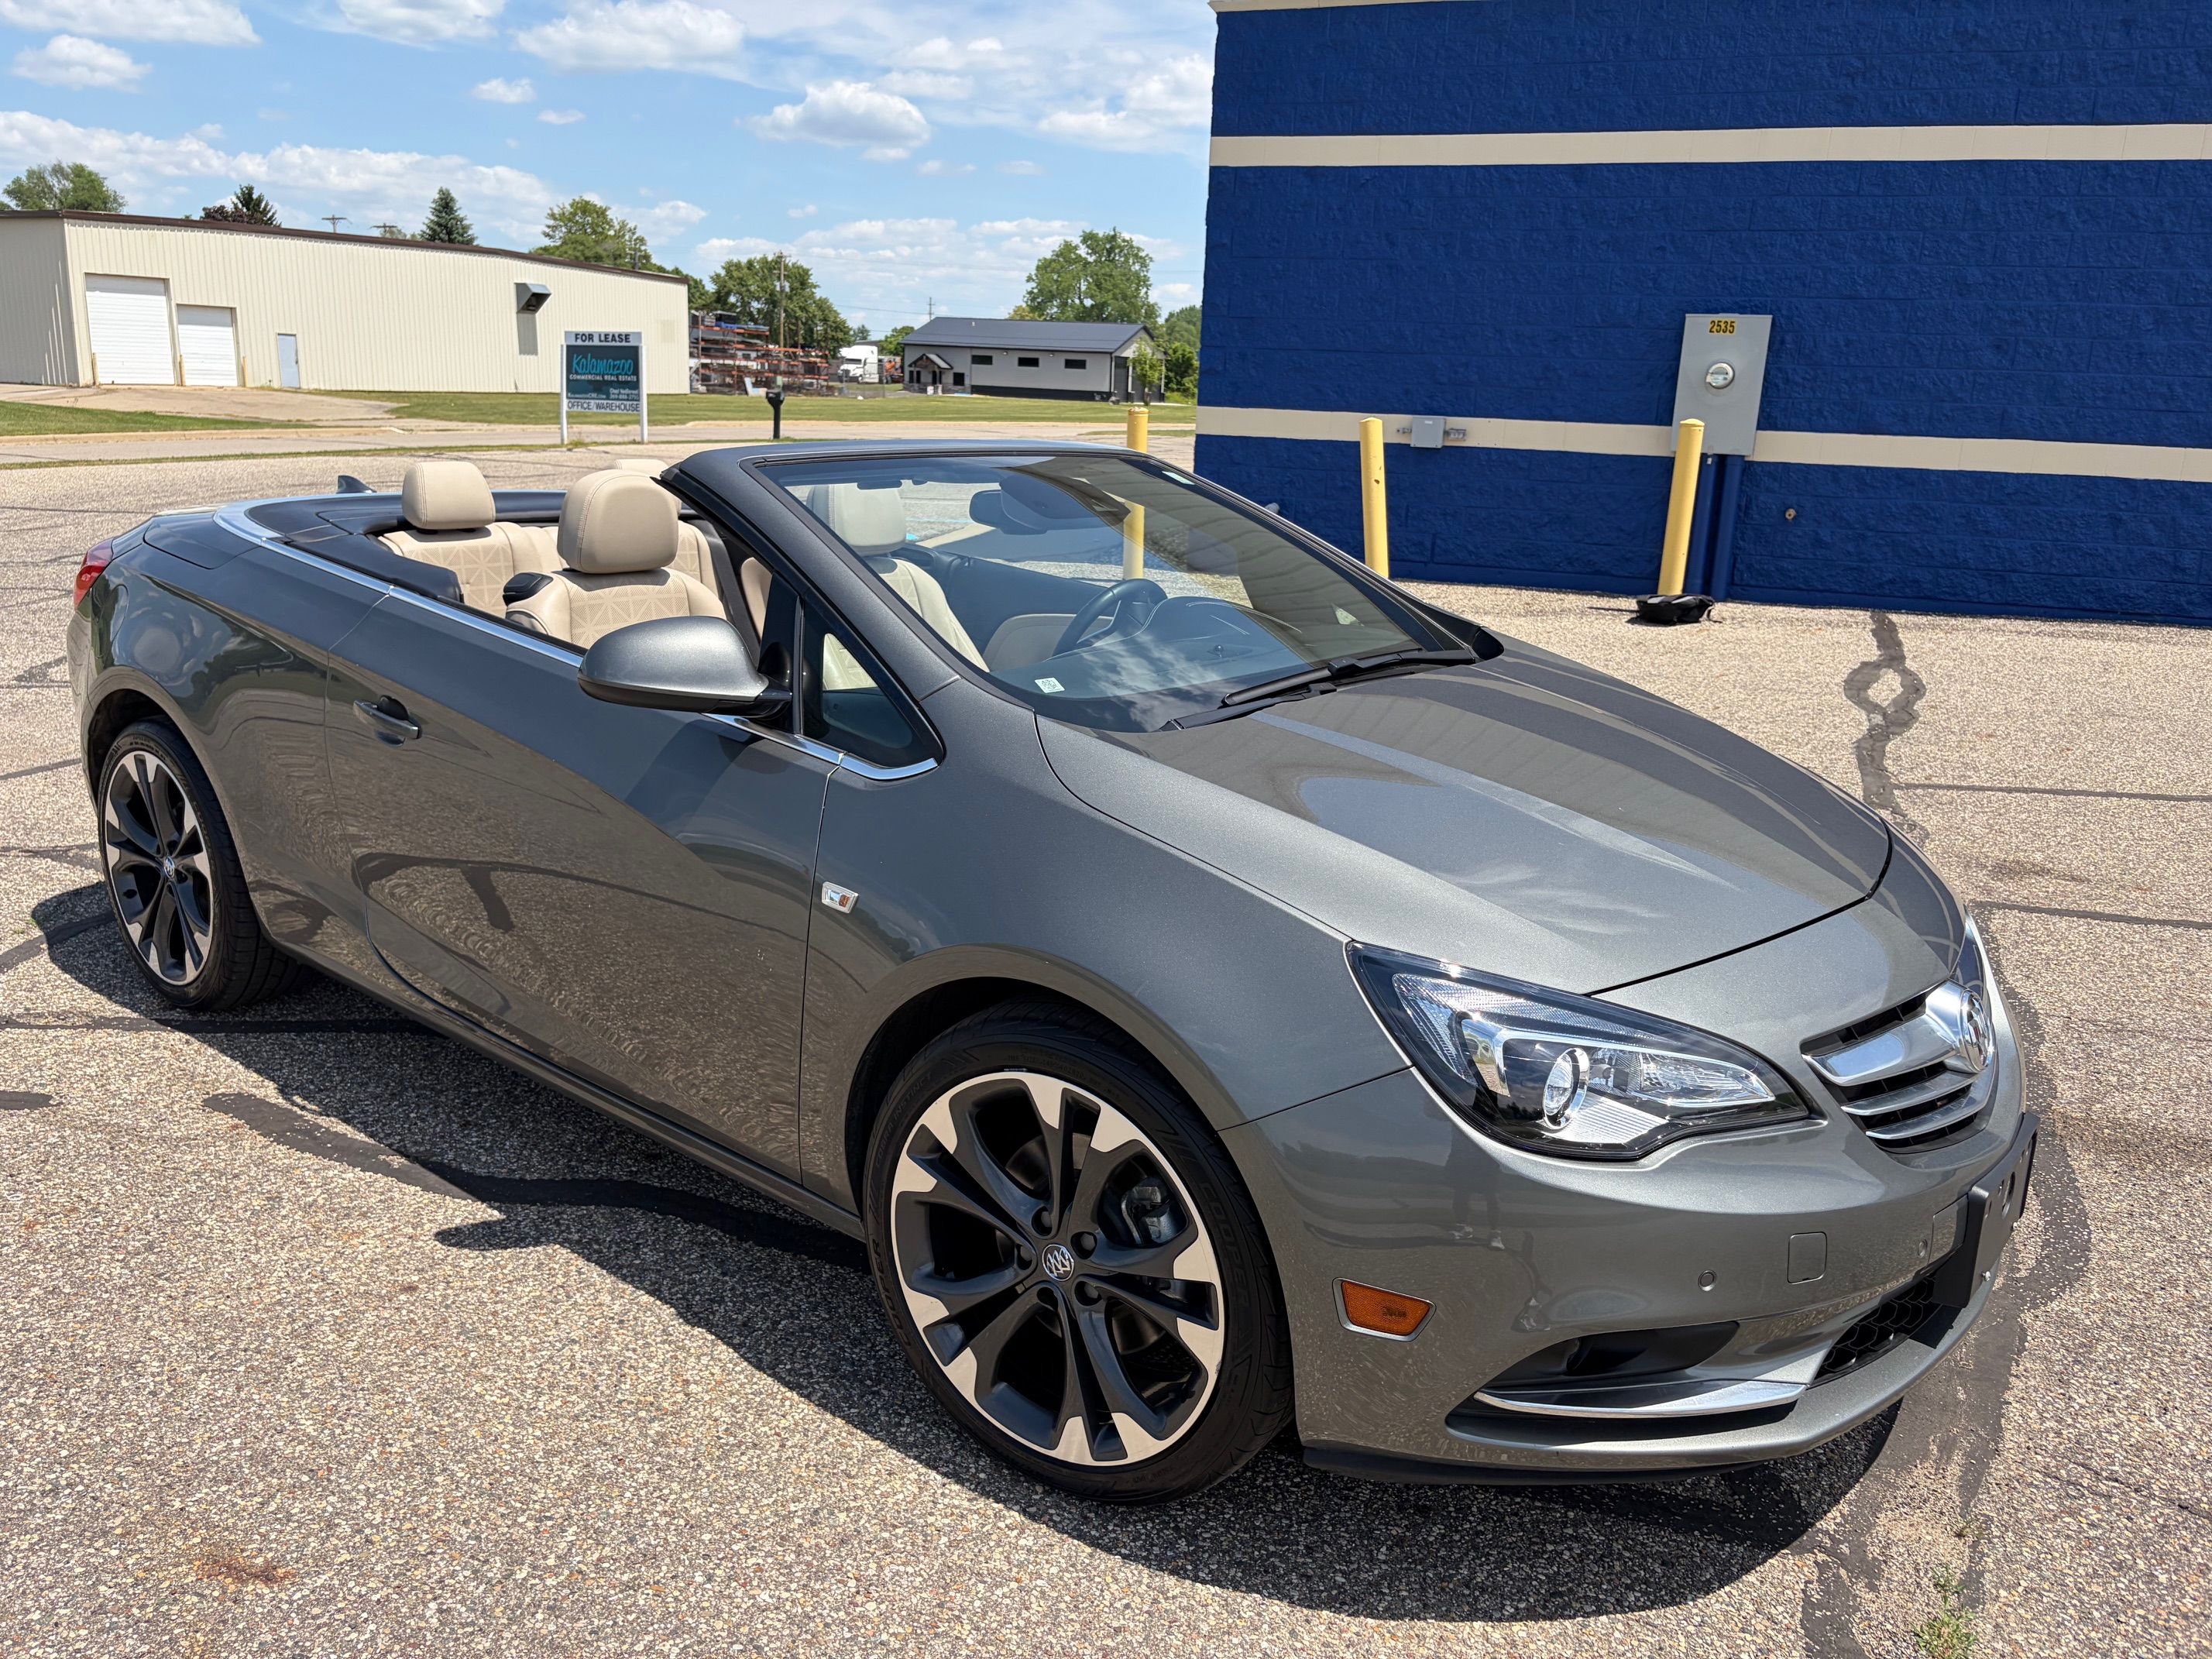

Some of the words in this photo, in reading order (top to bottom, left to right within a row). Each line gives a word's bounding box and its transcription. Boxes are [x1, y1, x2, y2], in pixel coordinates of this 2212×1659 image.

[1709, 320, 1735, 334] 2535
[575, 334, 594, 342] FOR
[599, 334, 630, 343] LEASE
[572, 353, 634, 374] Kalamazoo
[568, 401, 641, 411] OFFICE/WAREHOUSE
[871, 1238, 912, 1347] COOPER
